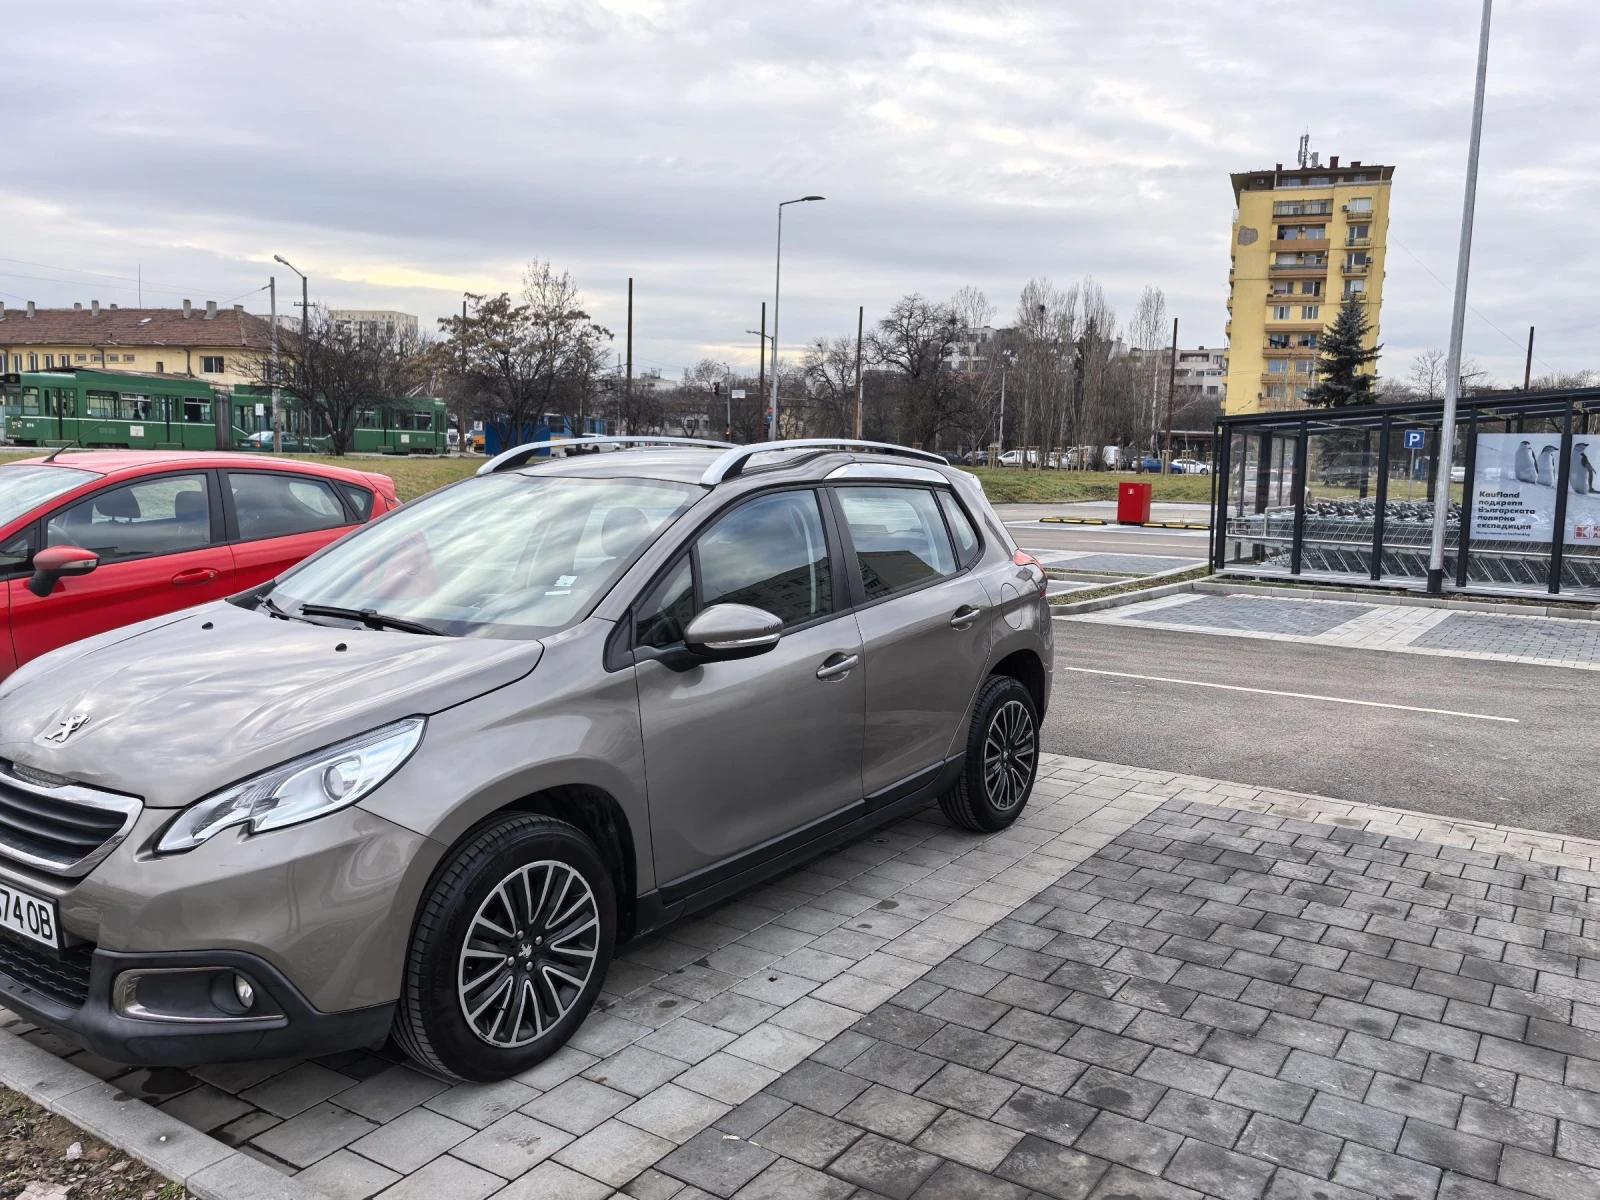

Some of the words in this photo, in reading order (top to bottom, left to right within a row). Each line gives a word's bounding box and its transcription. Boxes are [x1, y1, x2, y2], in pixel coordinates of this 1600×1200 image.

[1409, 433, 1420, 446] P
[1479, 491, 1520, 499] Kaufland
[1477, 506, 1536, 515] българската
[1477, 515, 1516, 523] полярна
[1476, 523, 1532, 531] експедиция
